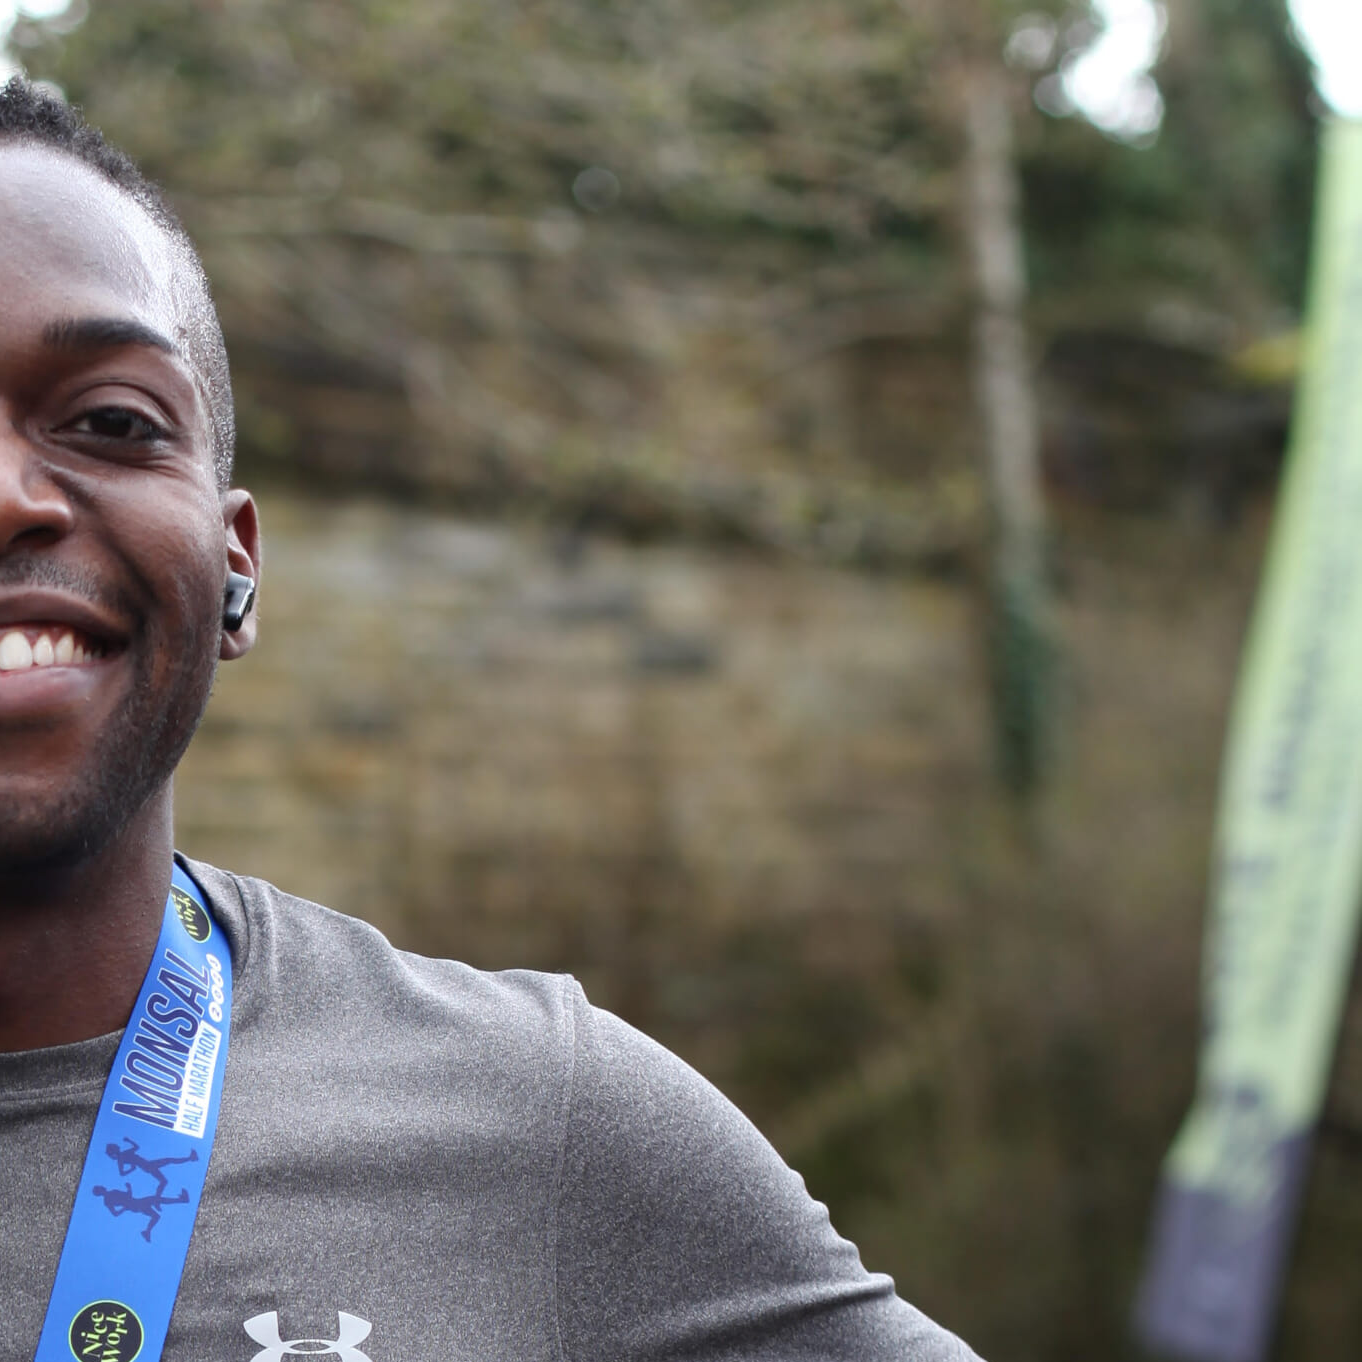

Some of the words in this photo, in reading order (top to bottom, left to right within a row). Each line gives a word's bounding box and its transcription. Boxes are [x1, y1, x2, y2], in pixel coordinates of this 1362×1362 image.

[113, 949, 211, 1130] MONSAL
[180, 1099, 204, 1133] HALF
[192, 1030, 218, 1097] MARATHON
[81, 1310, 105, 1358] Nice
